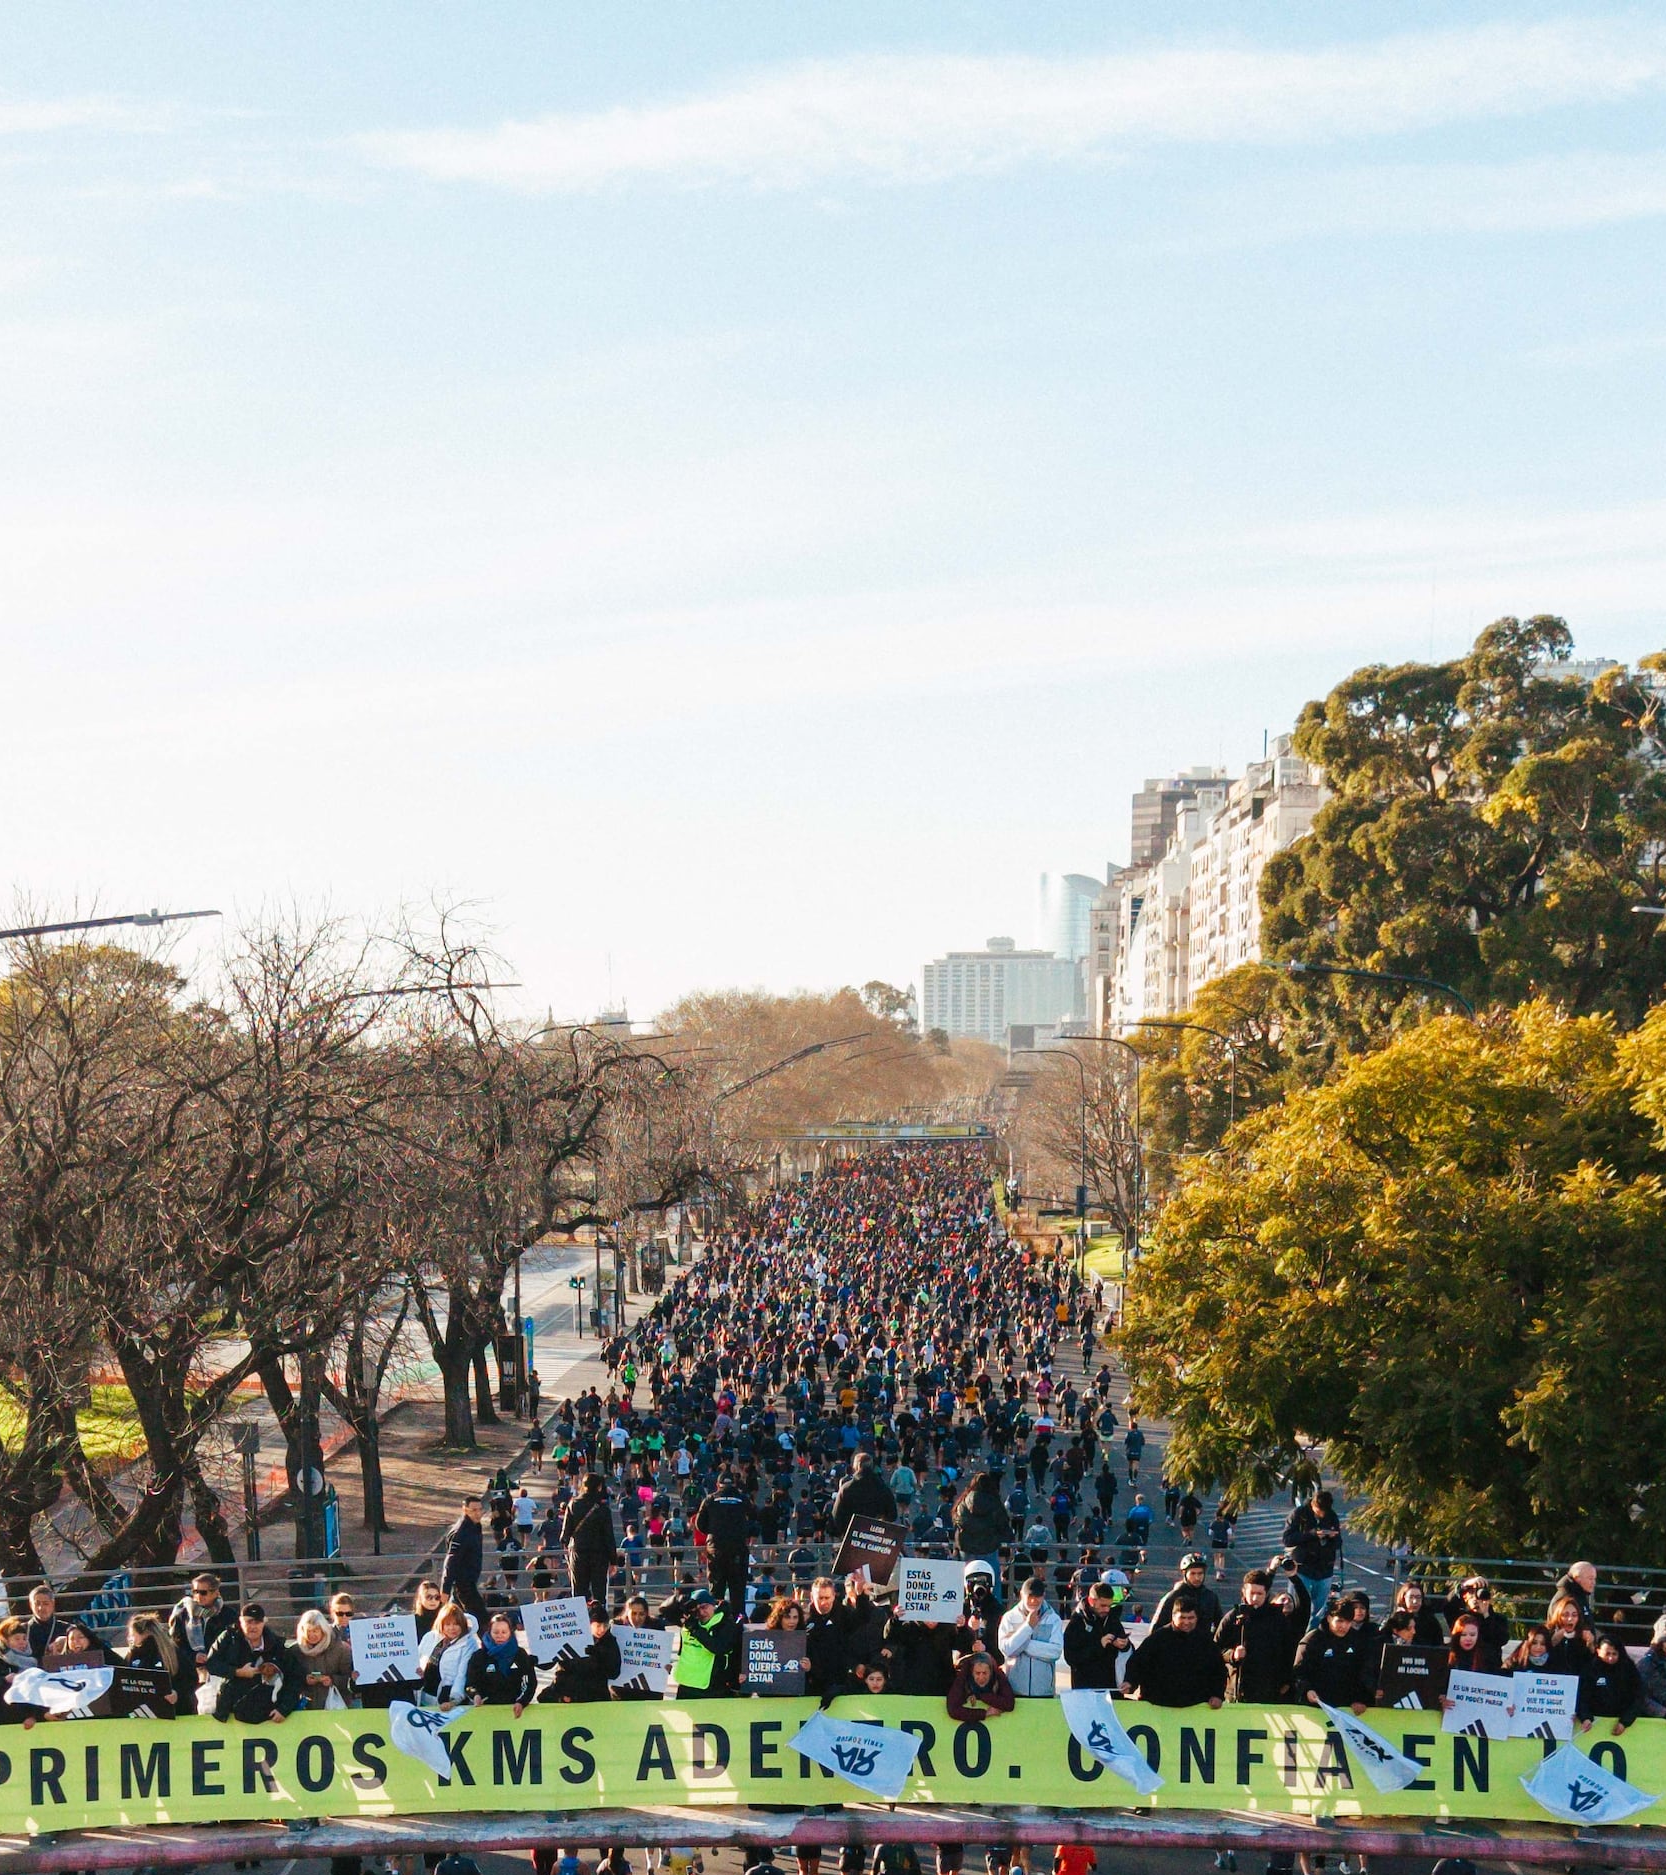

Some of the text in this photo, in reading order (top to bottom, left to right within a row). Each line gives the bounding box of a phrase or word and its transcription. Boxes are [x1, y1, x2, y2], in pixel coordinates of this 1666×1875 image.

[907, 1569, 931, 1579] ESTÁS
[906, 1581, 935, 1590] DONDE
[905, 1591, 938, 1601] QUERÉS
[905, 1602, 930, 1611] ESTAR
[749, 1639, 774, 1650] ESTÁS
[749, 1651, 778, 1661] DONDE
[748, 1673, 774, 1683] ESTAR
[1526, 1697, 1537, 1705] QUE
[437, 1725, 597, 1786] KMS
[1402, 1733, 1489, 1793] EN
